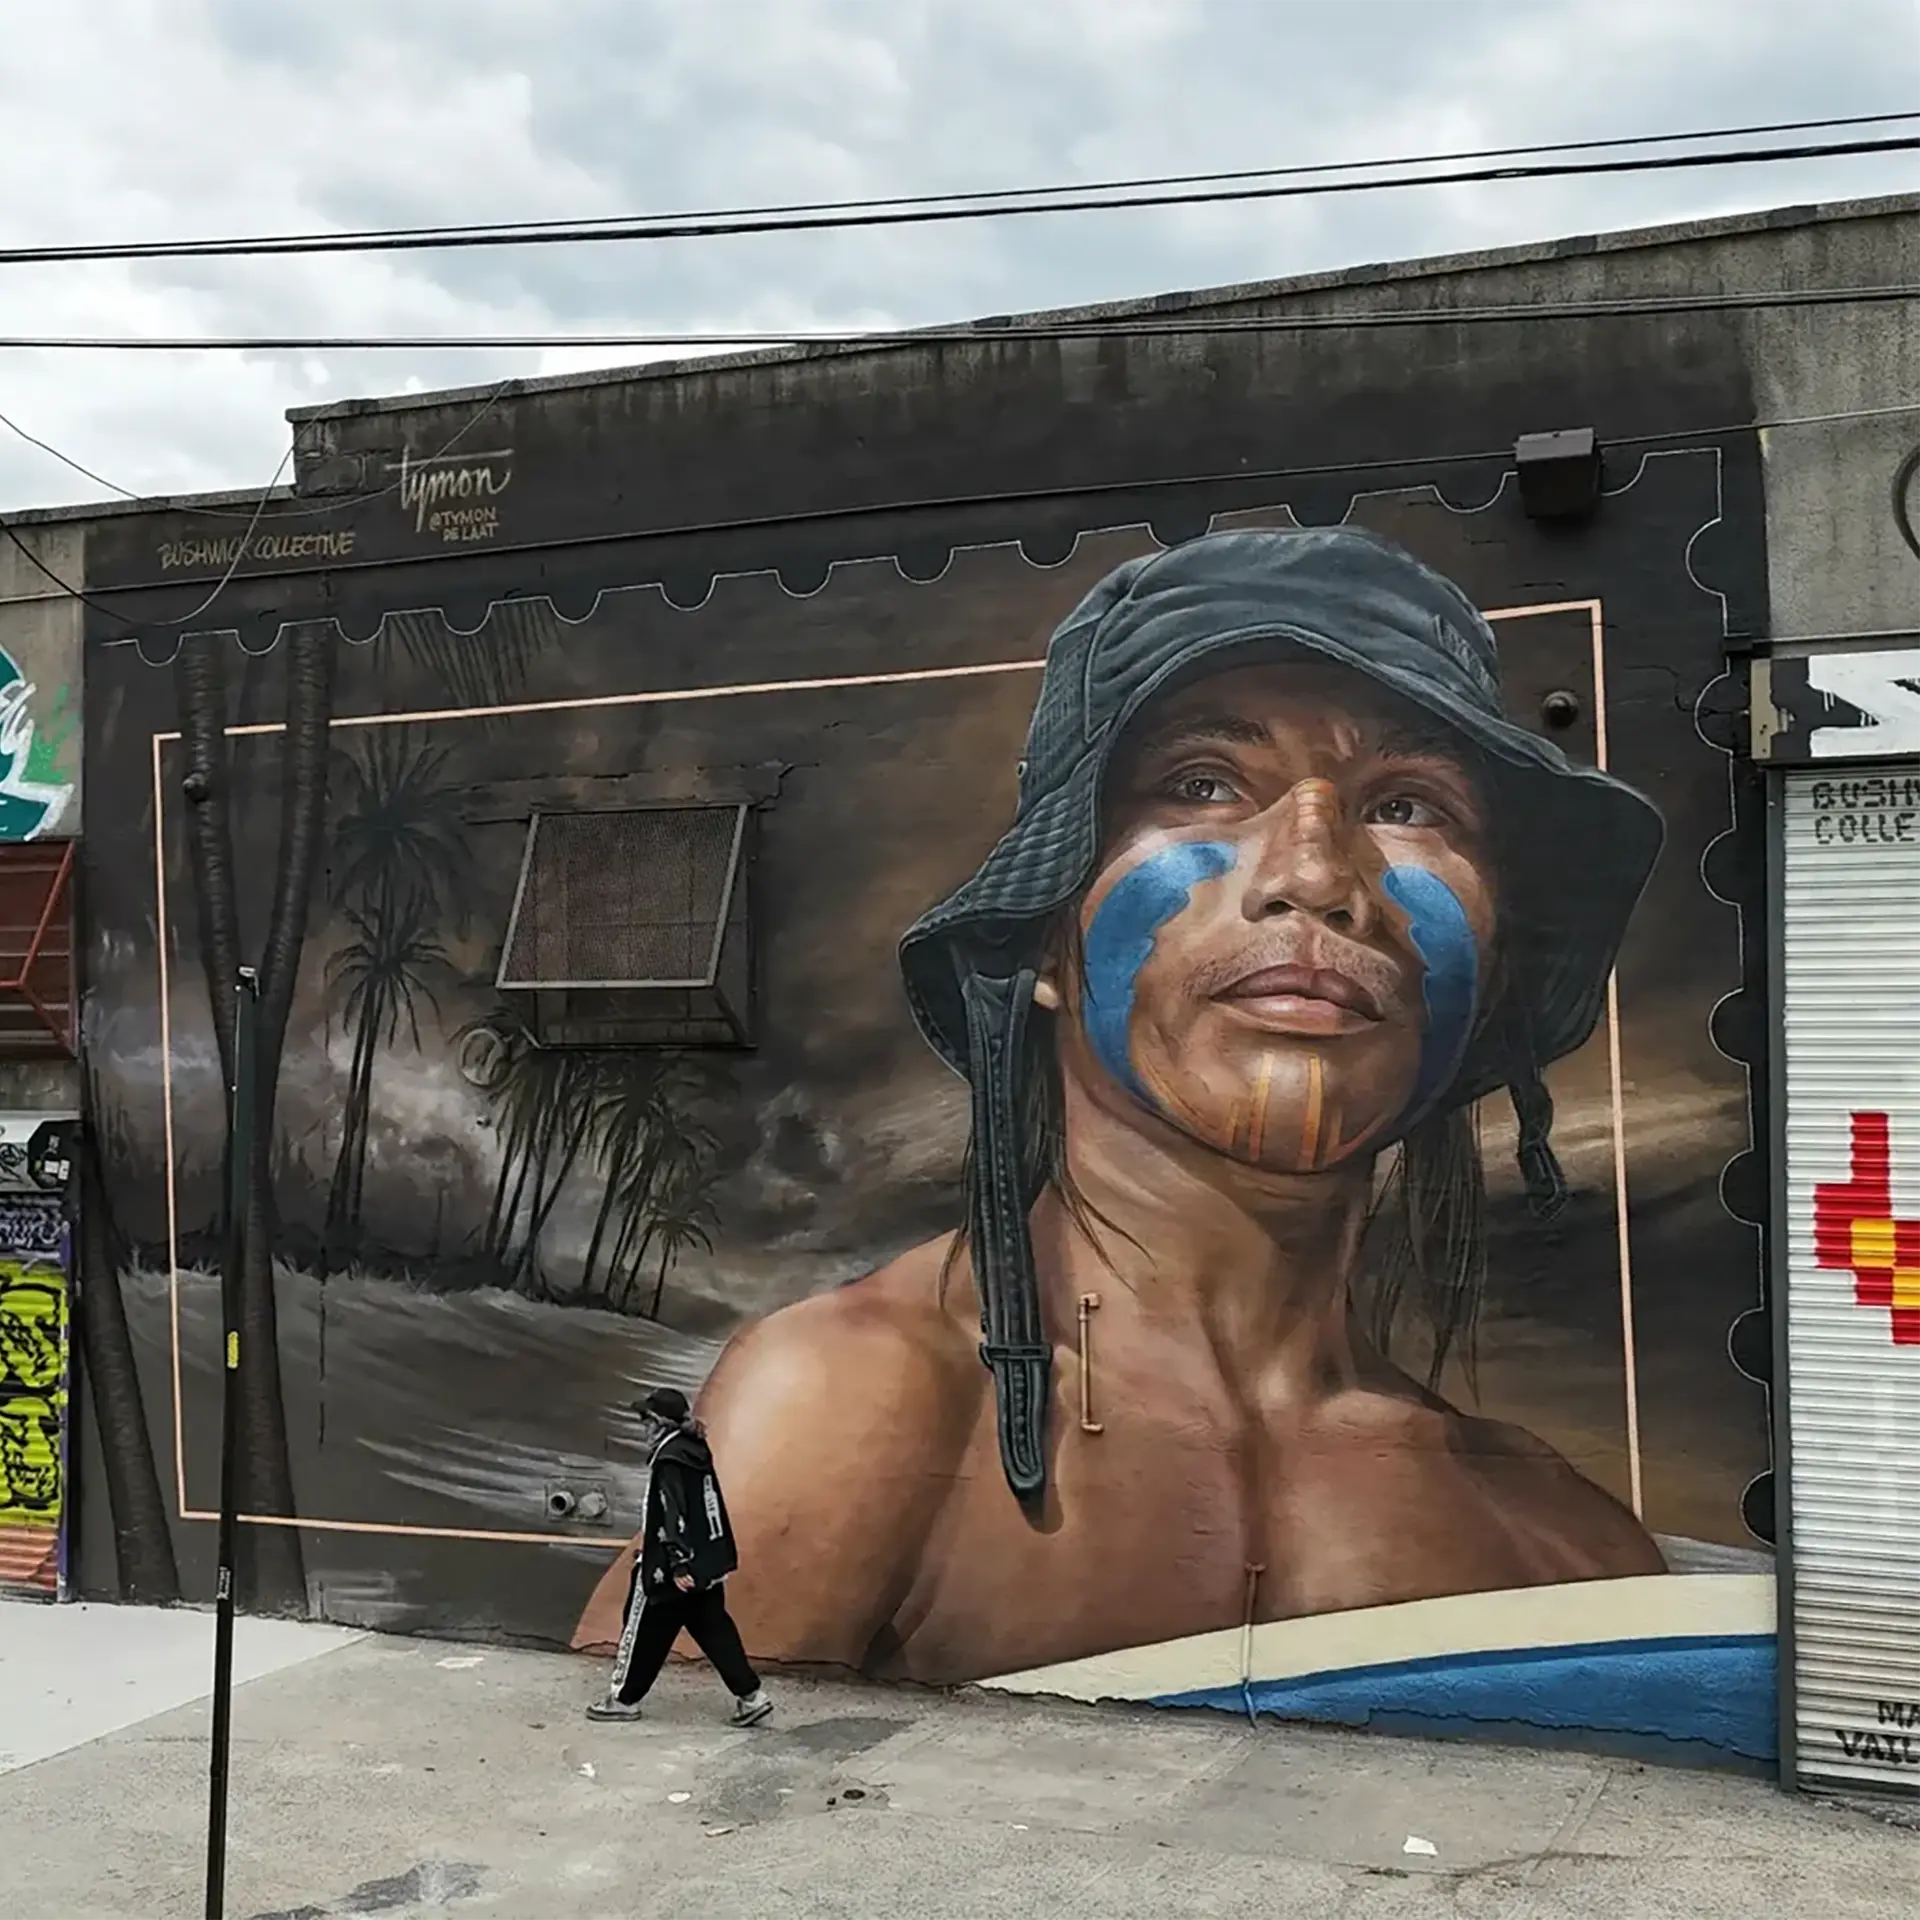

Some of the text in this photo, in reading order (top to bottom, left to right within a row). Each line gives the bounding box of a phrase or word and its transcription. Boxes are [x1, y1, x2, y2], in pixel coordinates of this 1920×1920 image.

[461, 521, 499, 541] LAAT
[158, 532, 356, 570] BUSHWICK COLLECTIVE
